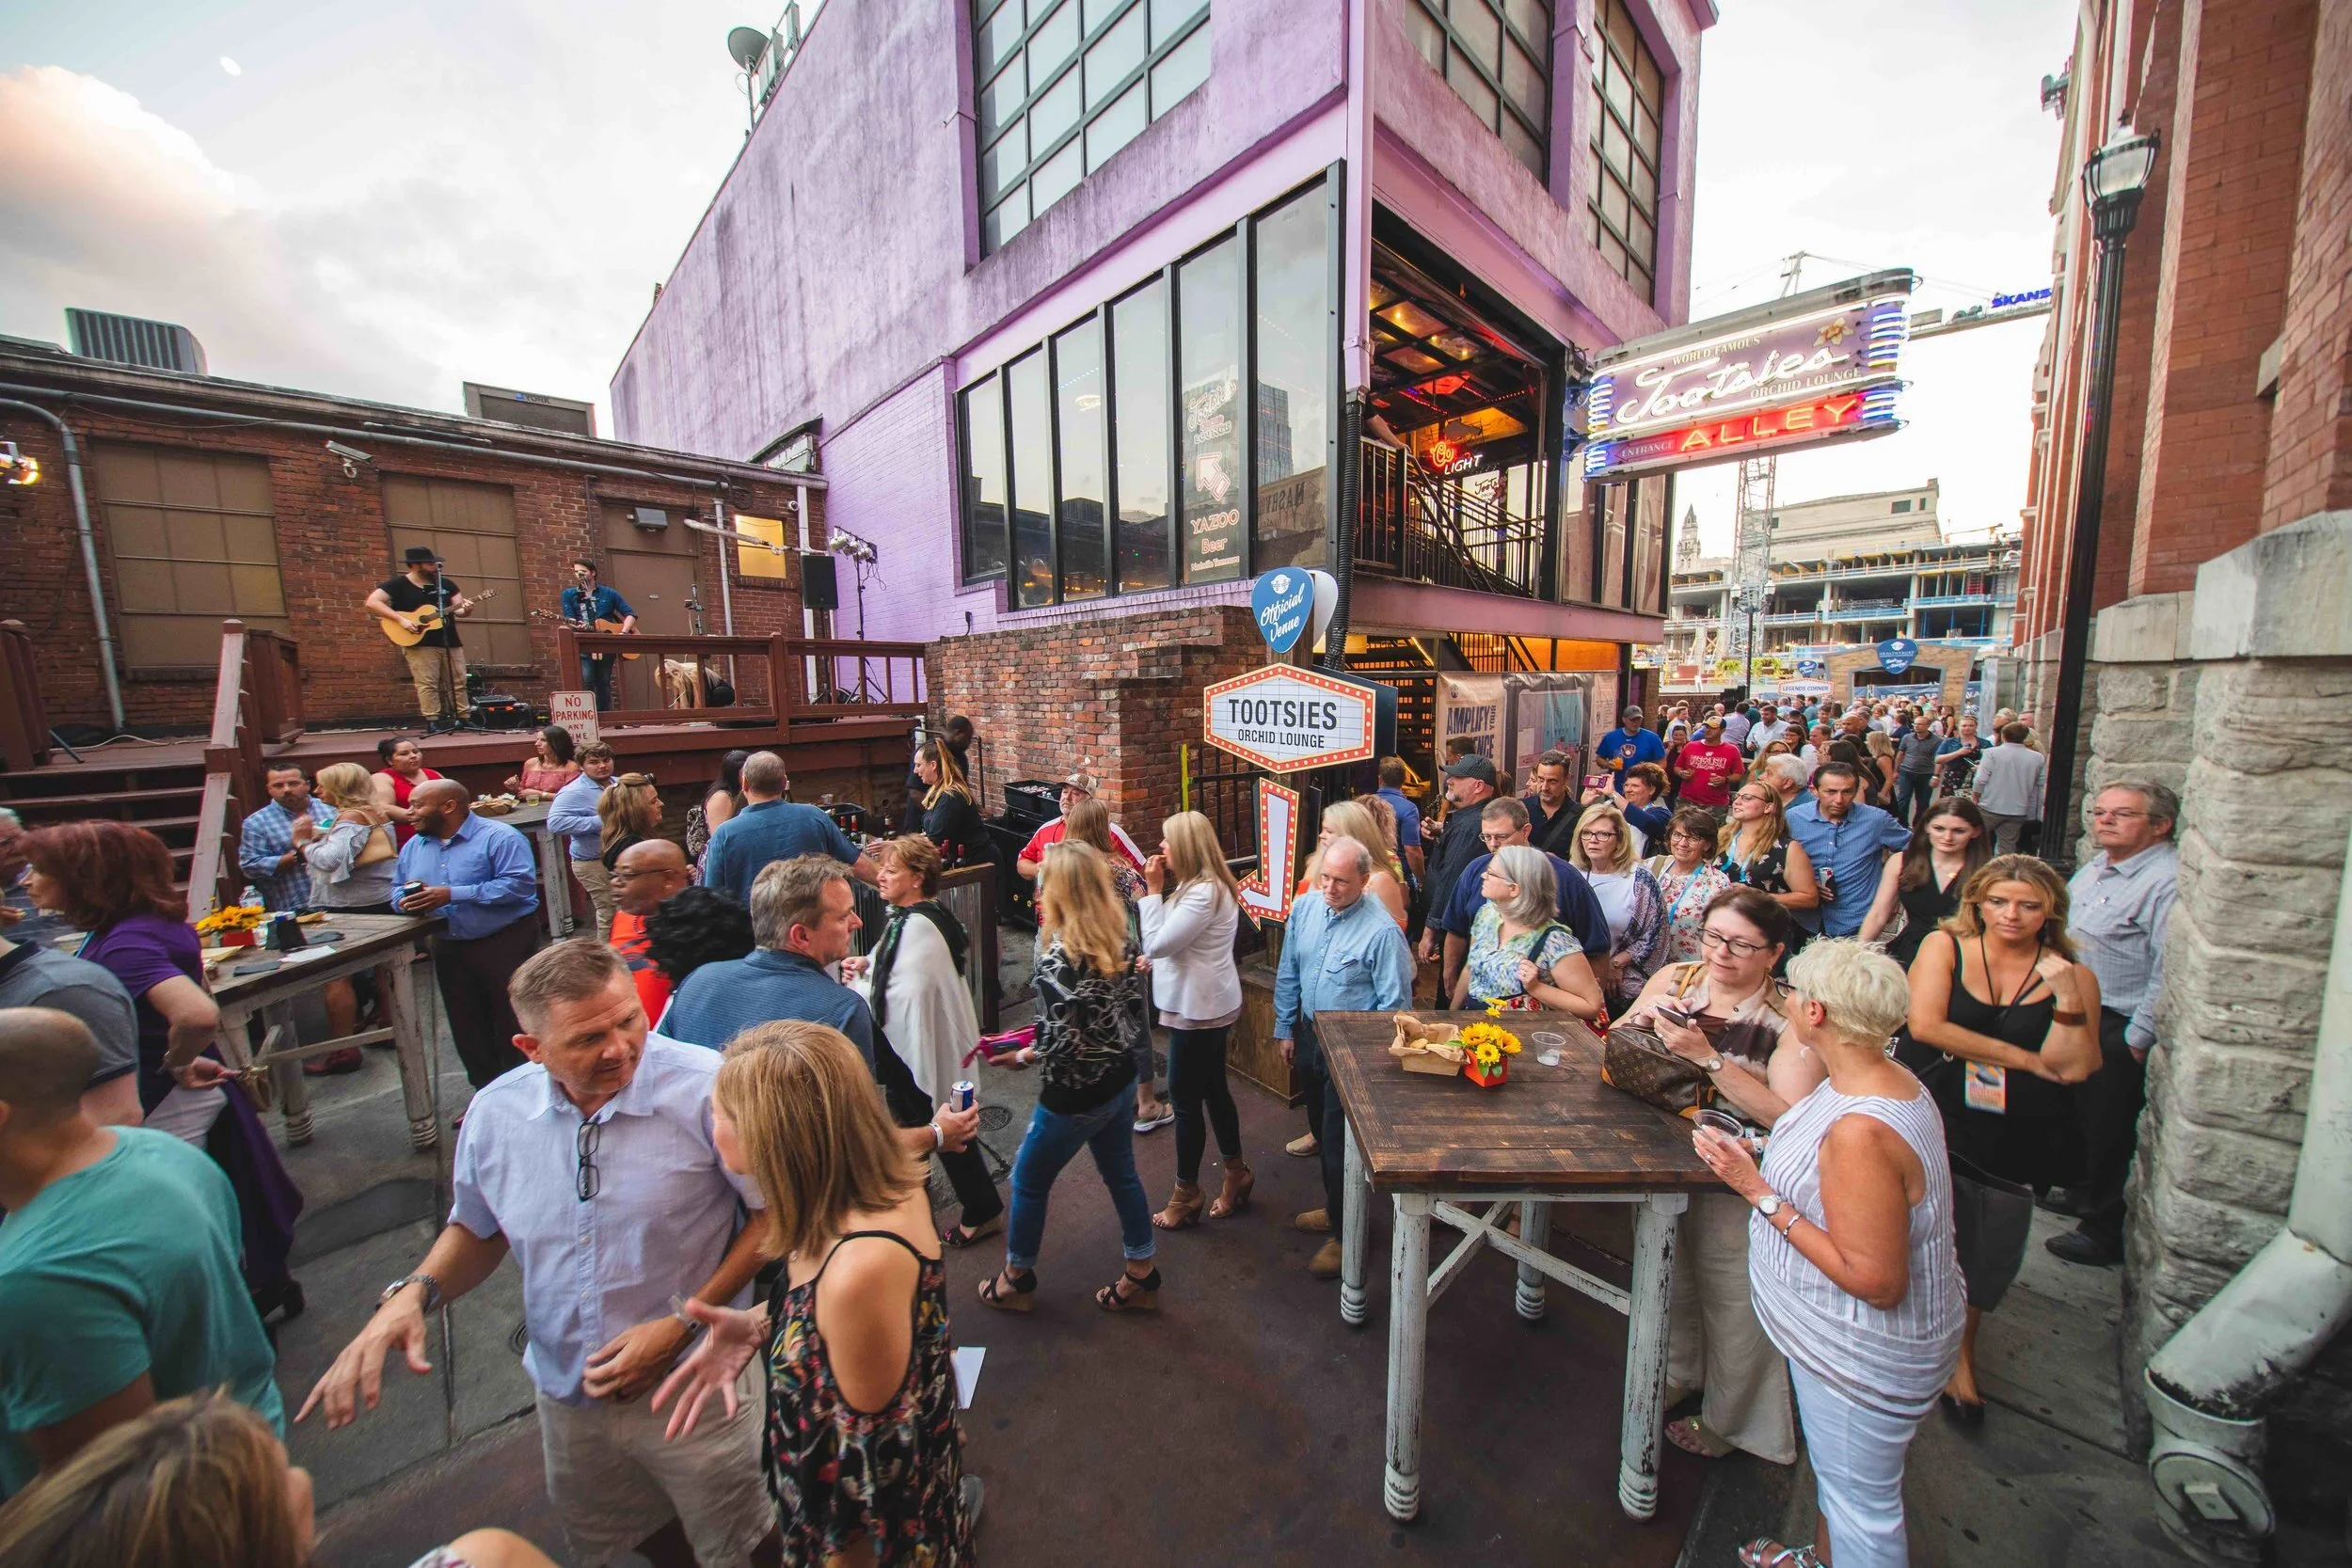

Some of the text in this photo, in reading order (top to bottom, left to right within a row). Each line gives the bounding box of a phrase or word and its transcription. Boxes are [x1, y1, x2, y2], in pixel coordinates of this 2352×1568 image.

[1672, 336, 1761, 366] WORLD FAMOUS
[1616, 346, 1851, 423] Tootsies
[1751, 368, 1861, 399] ORCHID LOUNGE
[1680, 399, 1857, 452] ALLEY
[1621, 440, 1675, 458] ENTRANCE
[1444, 453, 1484, 475] LIGHT
[1190, 509, 1240, 534] YAZOO
[1201, 538, 1228, 554] Beer
[1261, 582, 1305, 626] Official
[1270, 615, 1300, 642] Venue
[555, 709, 595, 721] PARKING
[564, 696, 581, 707] NO
[1228, 698, 1338, 731] TOOTSIES
[1447, 705, 1490, 735] AMPLIFY
[1237, 728, 1326, 749] ORCHID LOUNGE
